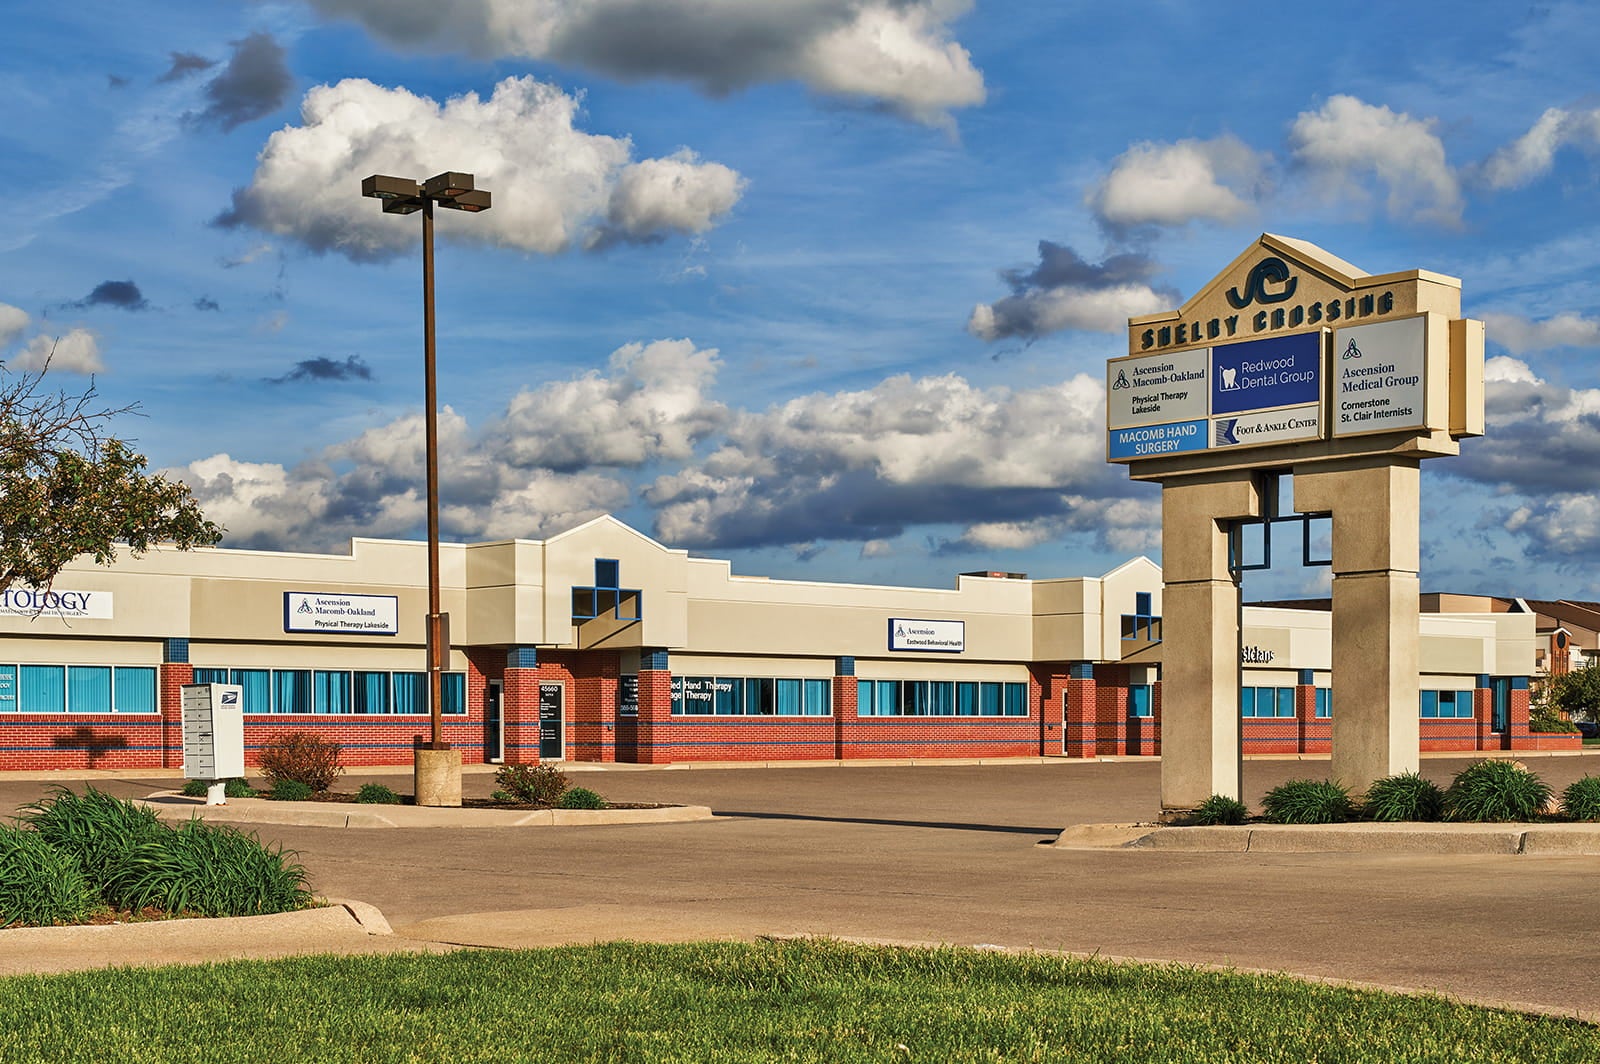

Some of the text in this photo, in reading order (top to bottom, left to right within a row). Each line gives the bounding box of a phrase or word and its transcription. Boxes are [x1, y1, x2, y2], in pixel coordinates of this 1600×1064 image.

[1141, 291, 1394, 350] SHELBY CROSSING
[1132, 362, 1174, 377] Ascension
[1241, 354, 1295, 374] Redwood
[1342, 363, 1395, 379] Ascension
[1132, 369, 1205, 388] Macomb-Oakland
[1241, 370, 1315, 390] Dental Group
[1342, 375, 1419, 393] Medical Group
[1132, 391, 1189, 405] Physical Therapy
[1341, 398, 1390, 411] Cornerstone
[1131, 403, 1161, 415] Lakeside
[1341, 406, 1413, 423] St. Clair Internists
[1119, 424, 1197, 444] MACOMB HAND
[1255, 423, 1263, 433] &
[1135, 439, 1181, 455] SURGERY
[0, 589, 91, 610] TOLOGY
[315, 598, 351, 607] Ascension
[315, 607, 376, 617] Macomb-Oakland
[314, 619, 389, 630] Physical Therapy Lakeside
[907, 627, 936, 636] Ascension
[1241, 646, 1275, 662] sicians
[684, 681, 702, 690] Hand
[705, 681, 733, 693] Therapy
[686, 690, 712, 702] Therapy
